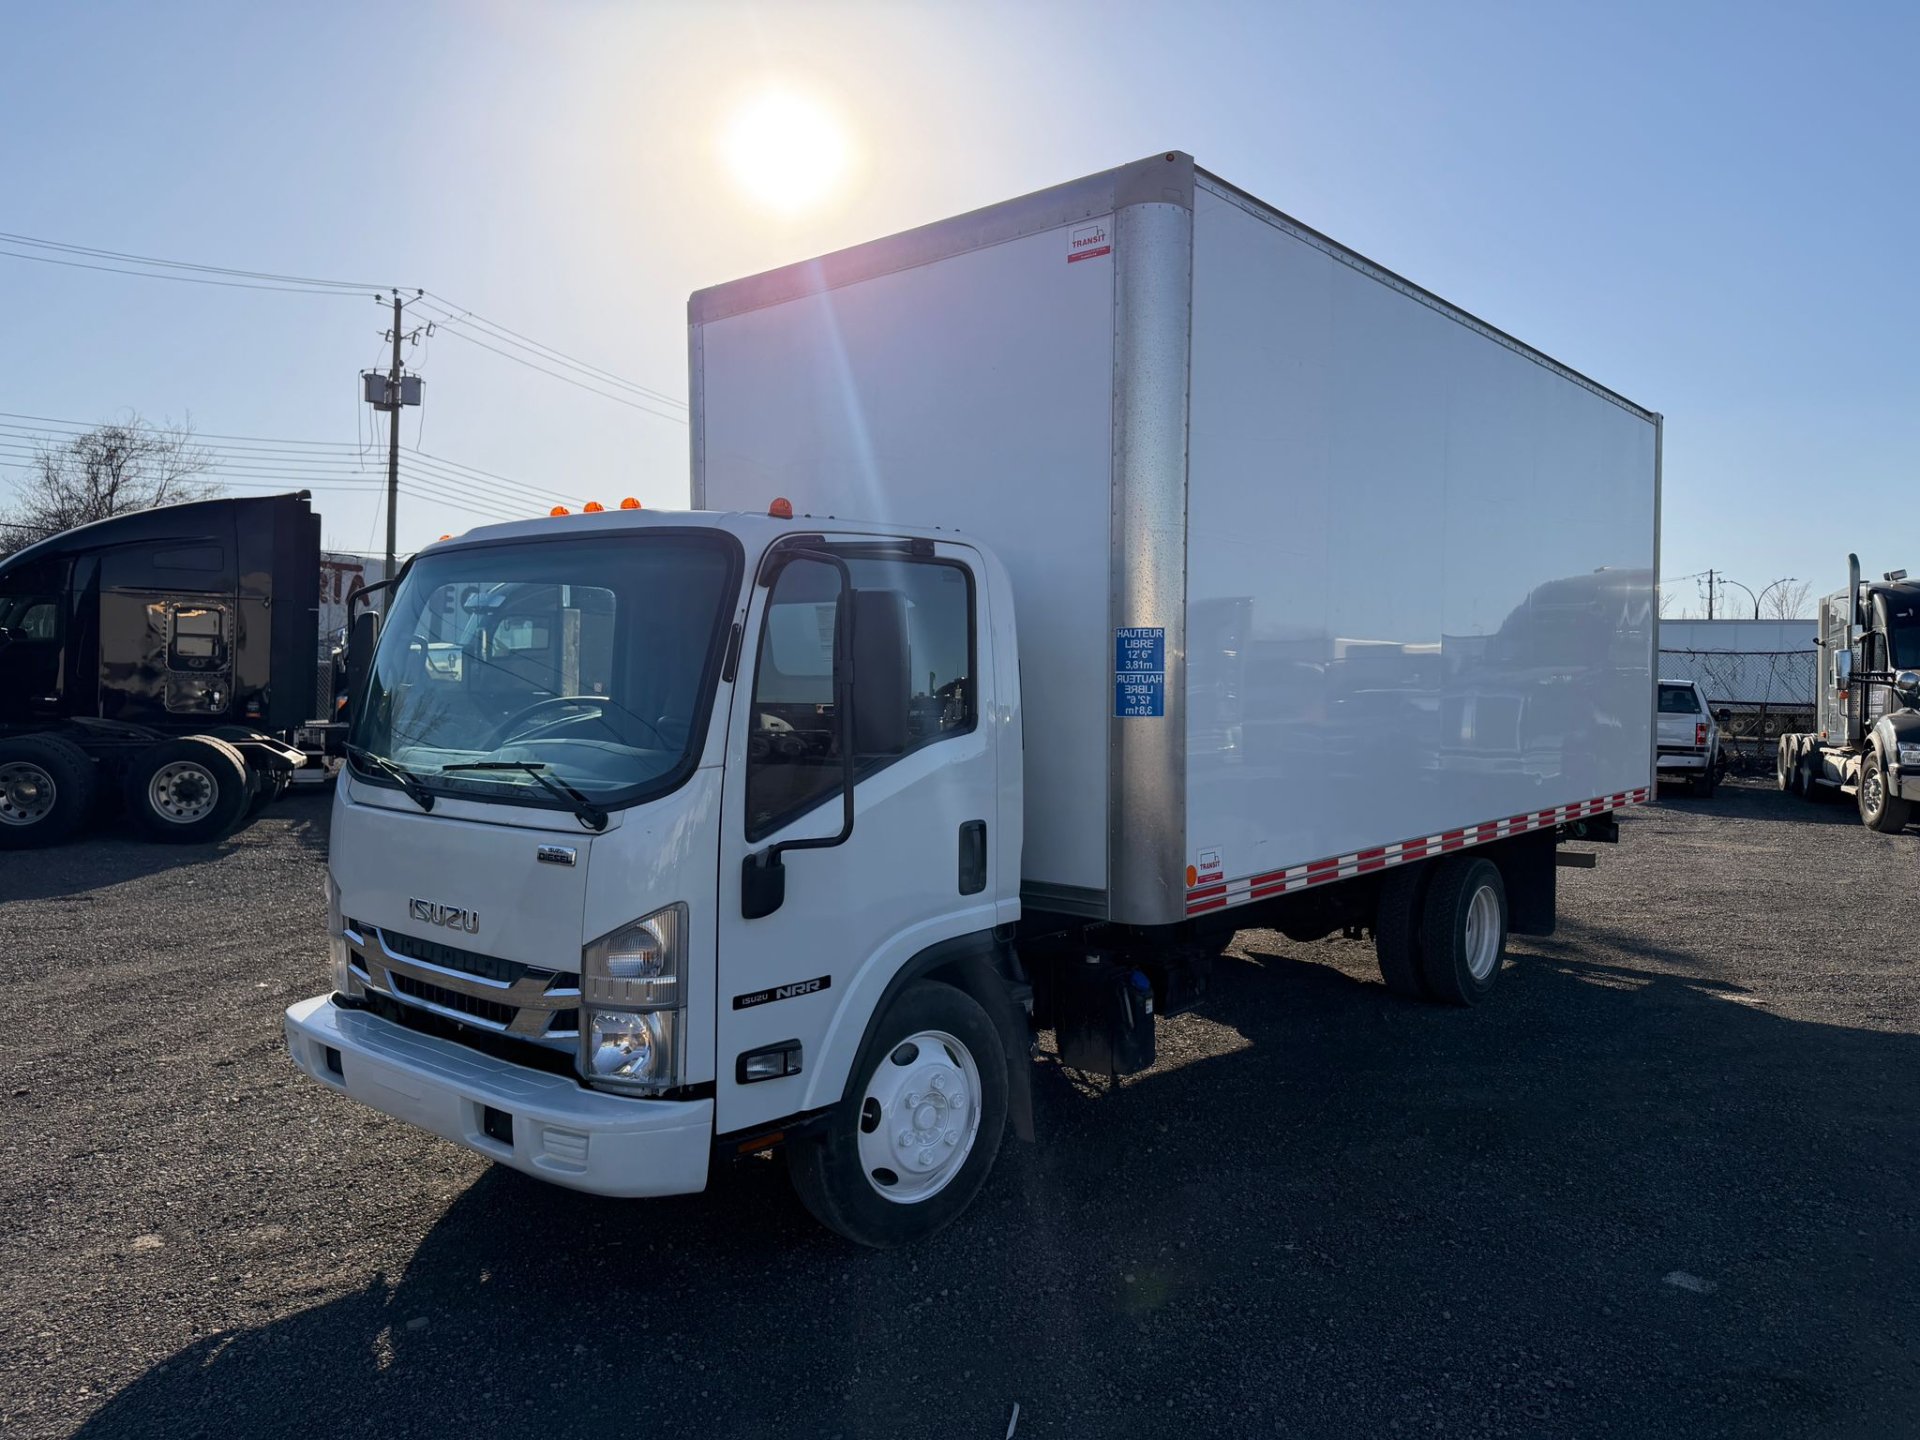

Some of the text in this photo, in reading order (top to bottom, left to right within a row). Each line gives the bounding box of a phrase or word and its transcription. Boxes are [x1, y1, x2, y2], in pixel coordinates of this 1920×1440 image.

[1072, 233, 1106, 248] TRANSIT
[1117, 629, 1163, 638] HAUTEUR
[1125, 639, 1154, 649] LIBRE
[1128, 650, 1152, 659] 12' 6"
[1125, 660, 1153, 670] 3,81m
[538, 852, 573, 864] DIESEL
[1200, 860, 1220, 870] TRANSIT
[409, 896, 480, 935] ISUZU
[742, 980, 821, 1005] ISUZU NRR
